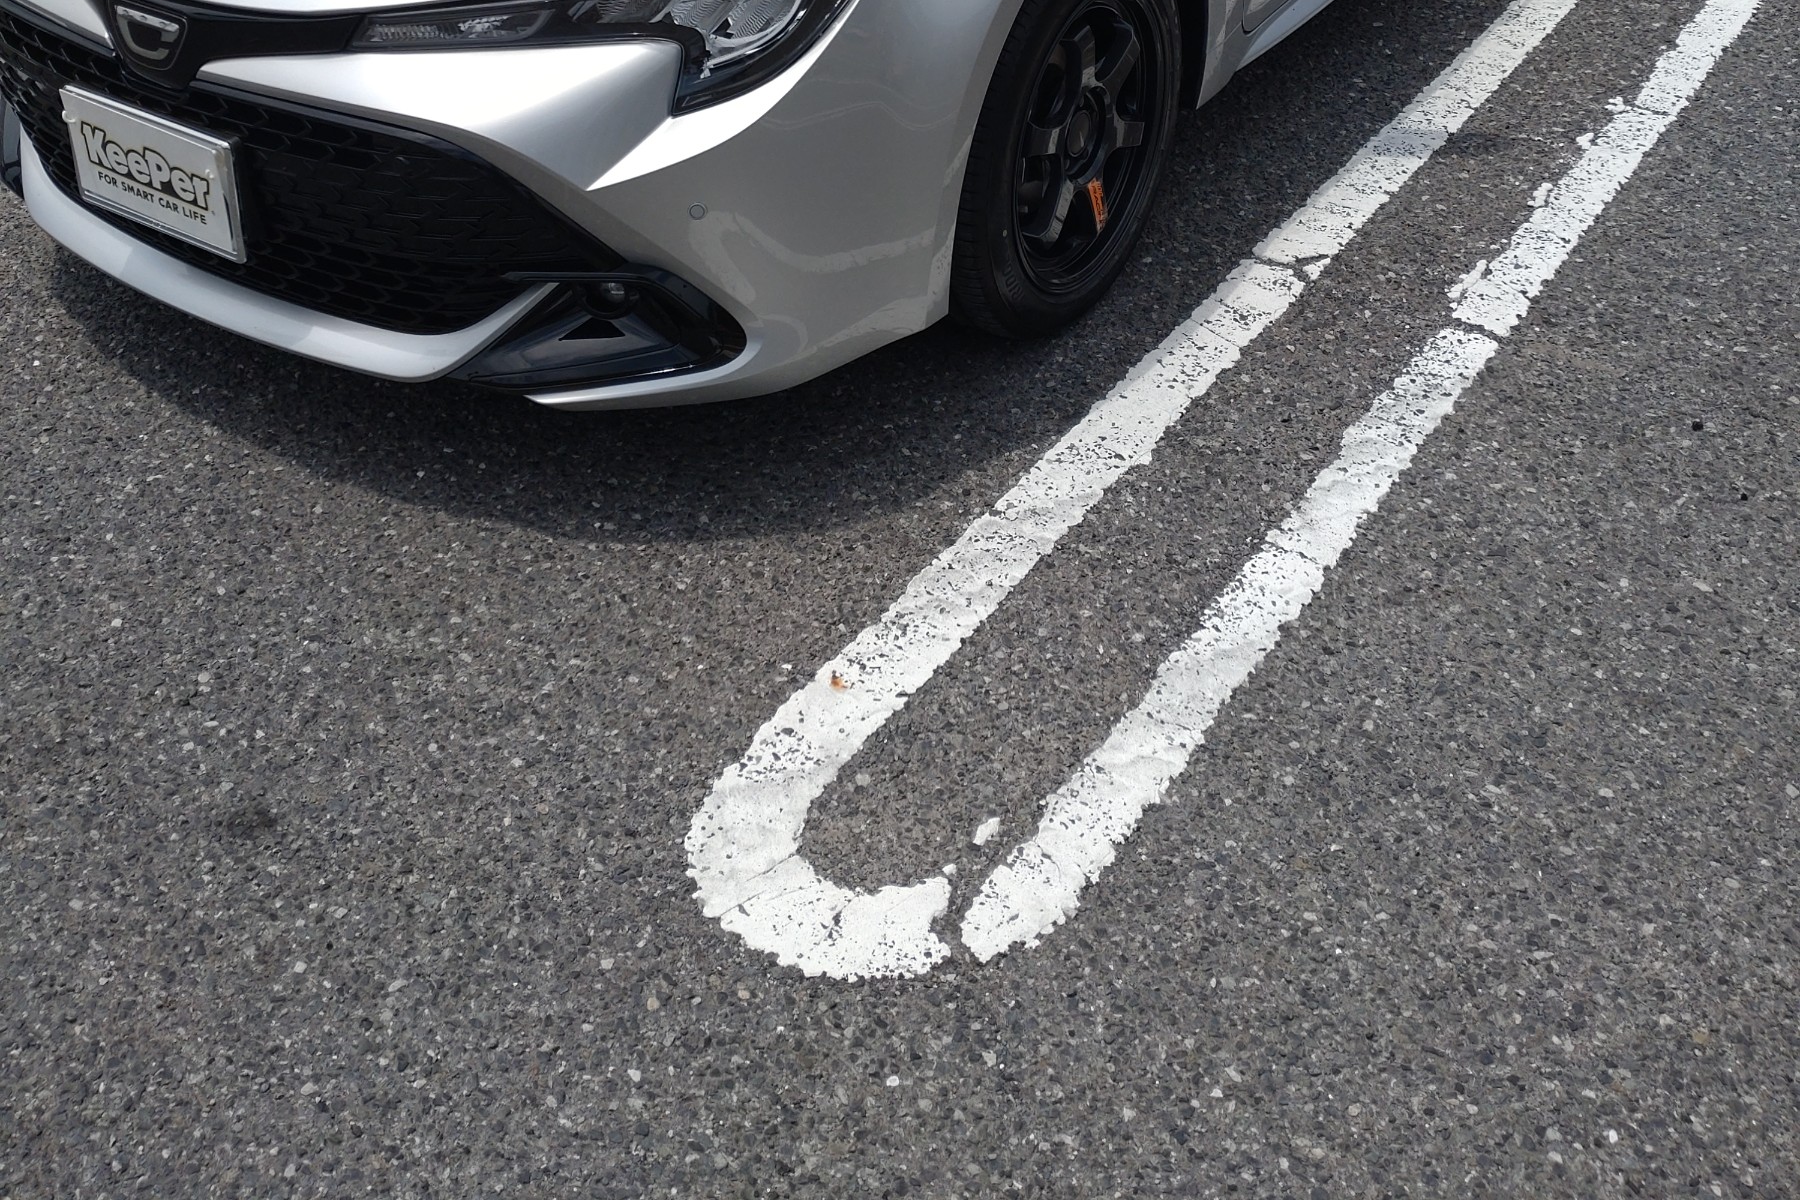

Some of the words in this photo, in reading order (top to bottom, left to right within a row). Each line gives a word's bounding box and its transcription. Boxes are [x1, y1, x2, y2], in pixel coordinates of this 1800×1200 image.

[81, 121, 210, 211] KeePer
[98, 171, 118, 187] FOR
[121, 181, 154, 203] SMART
[158, 197, 179, 214] CAR
[182, 205, 208, 225] LIFE
